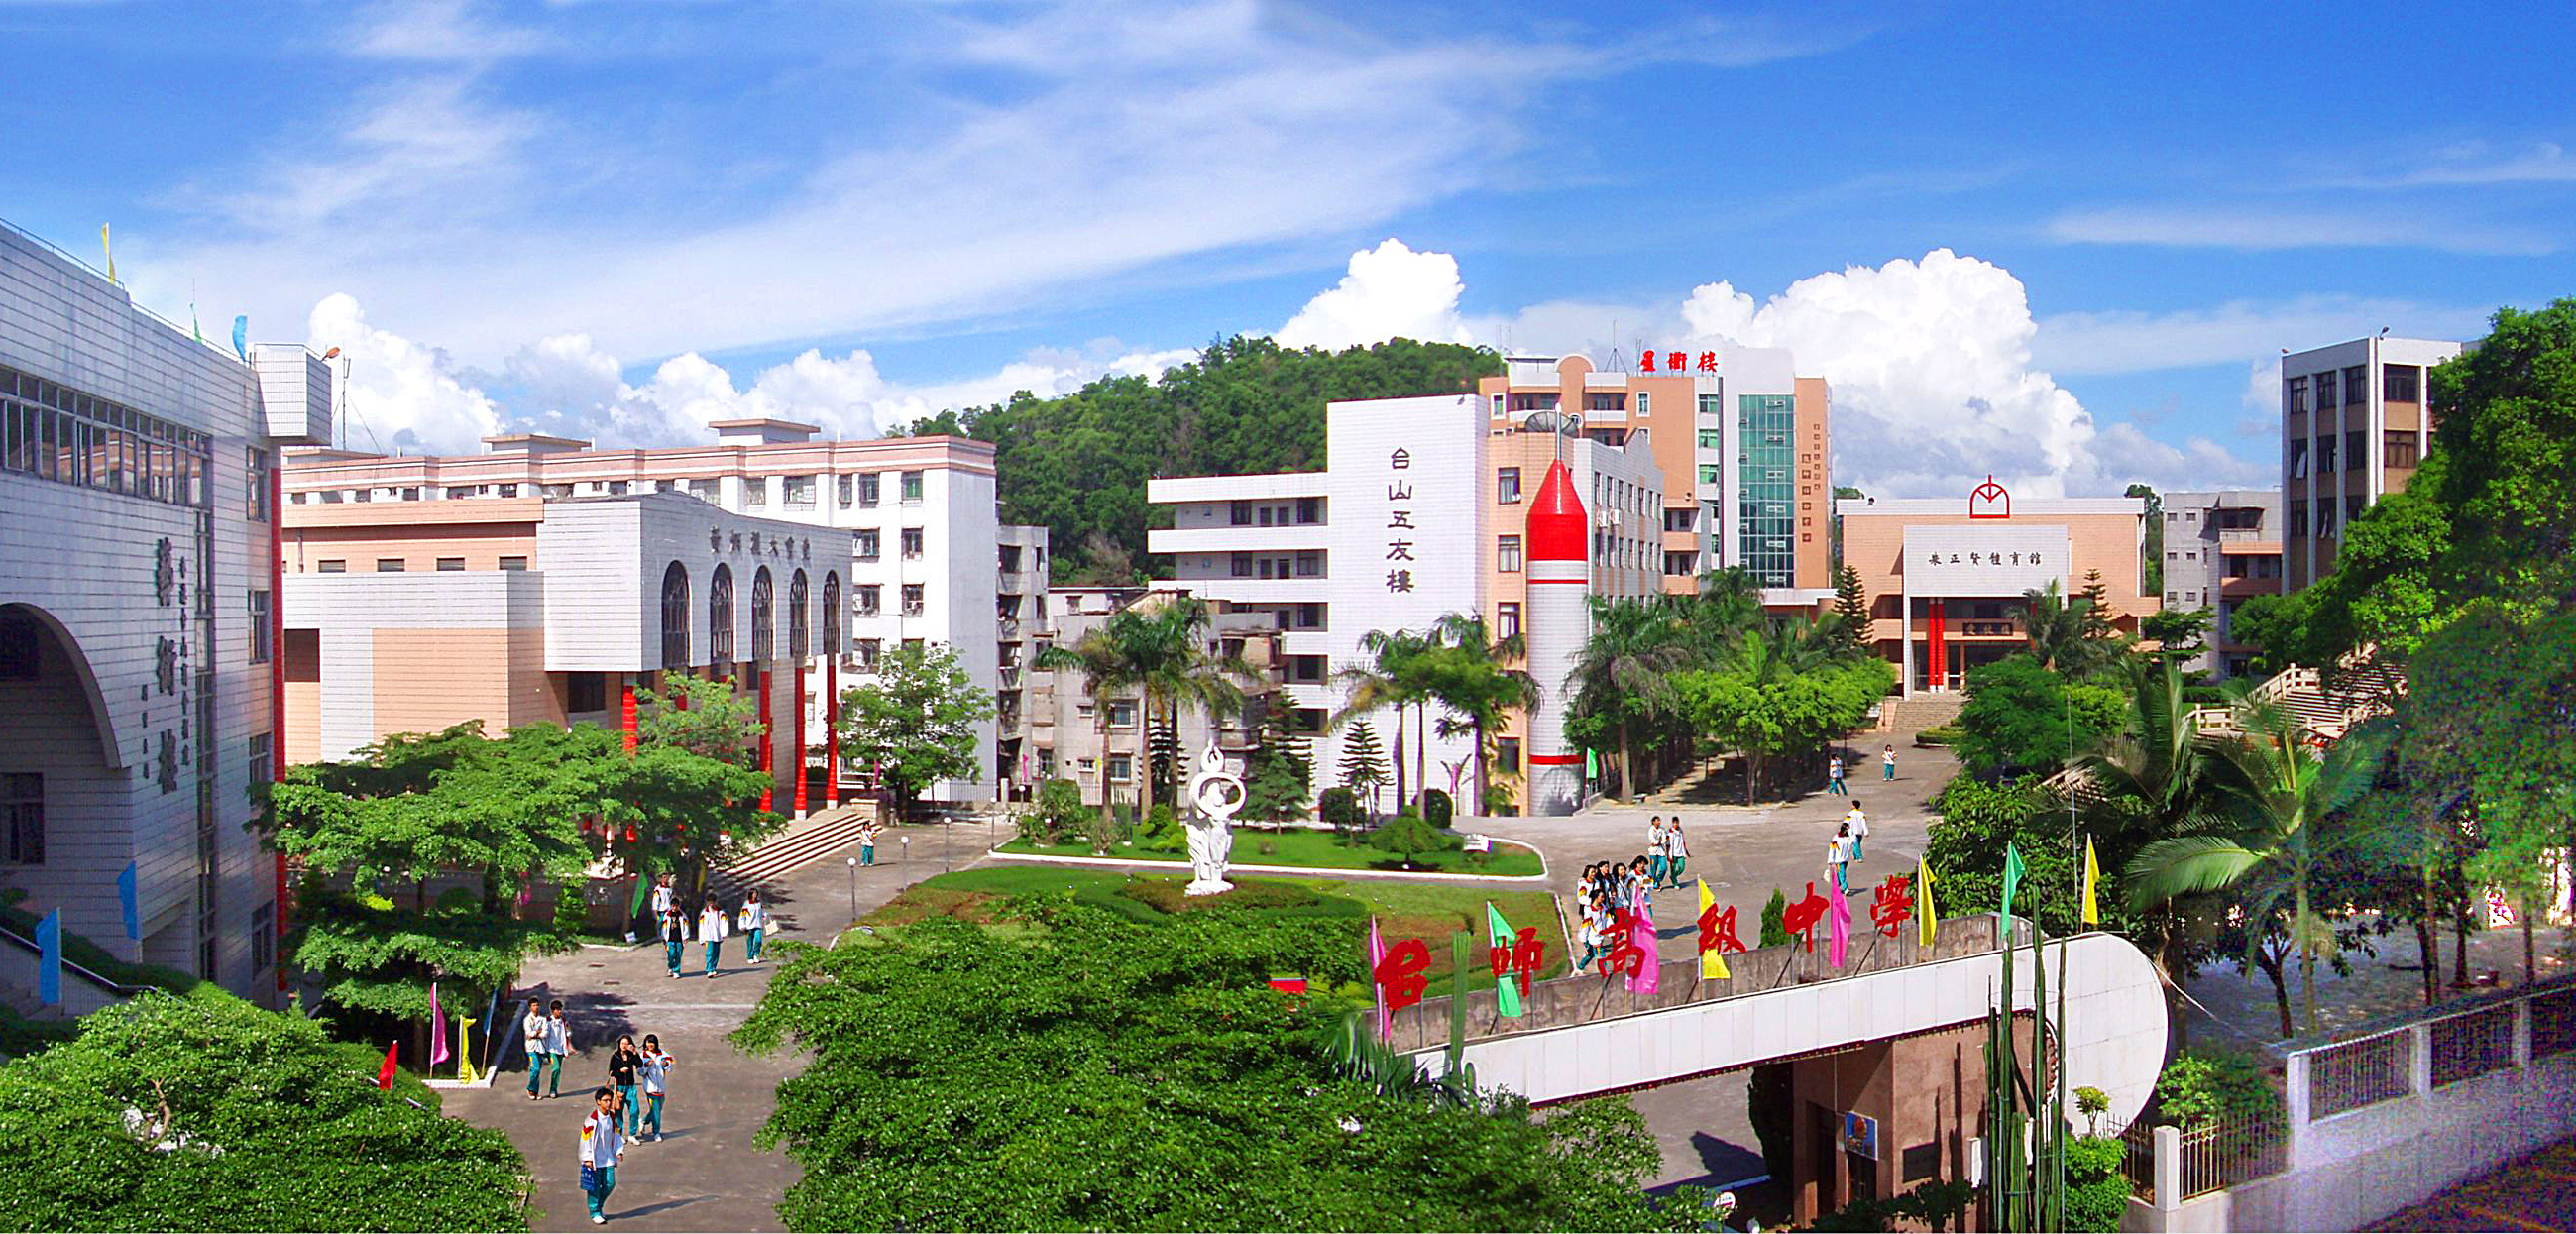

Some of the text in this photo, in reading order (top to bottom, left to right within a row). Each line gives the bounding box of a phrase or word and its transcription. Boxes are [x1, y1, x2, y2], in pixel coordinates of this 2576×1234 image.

[1386, 446, 1415, 594] 台山五友樓
